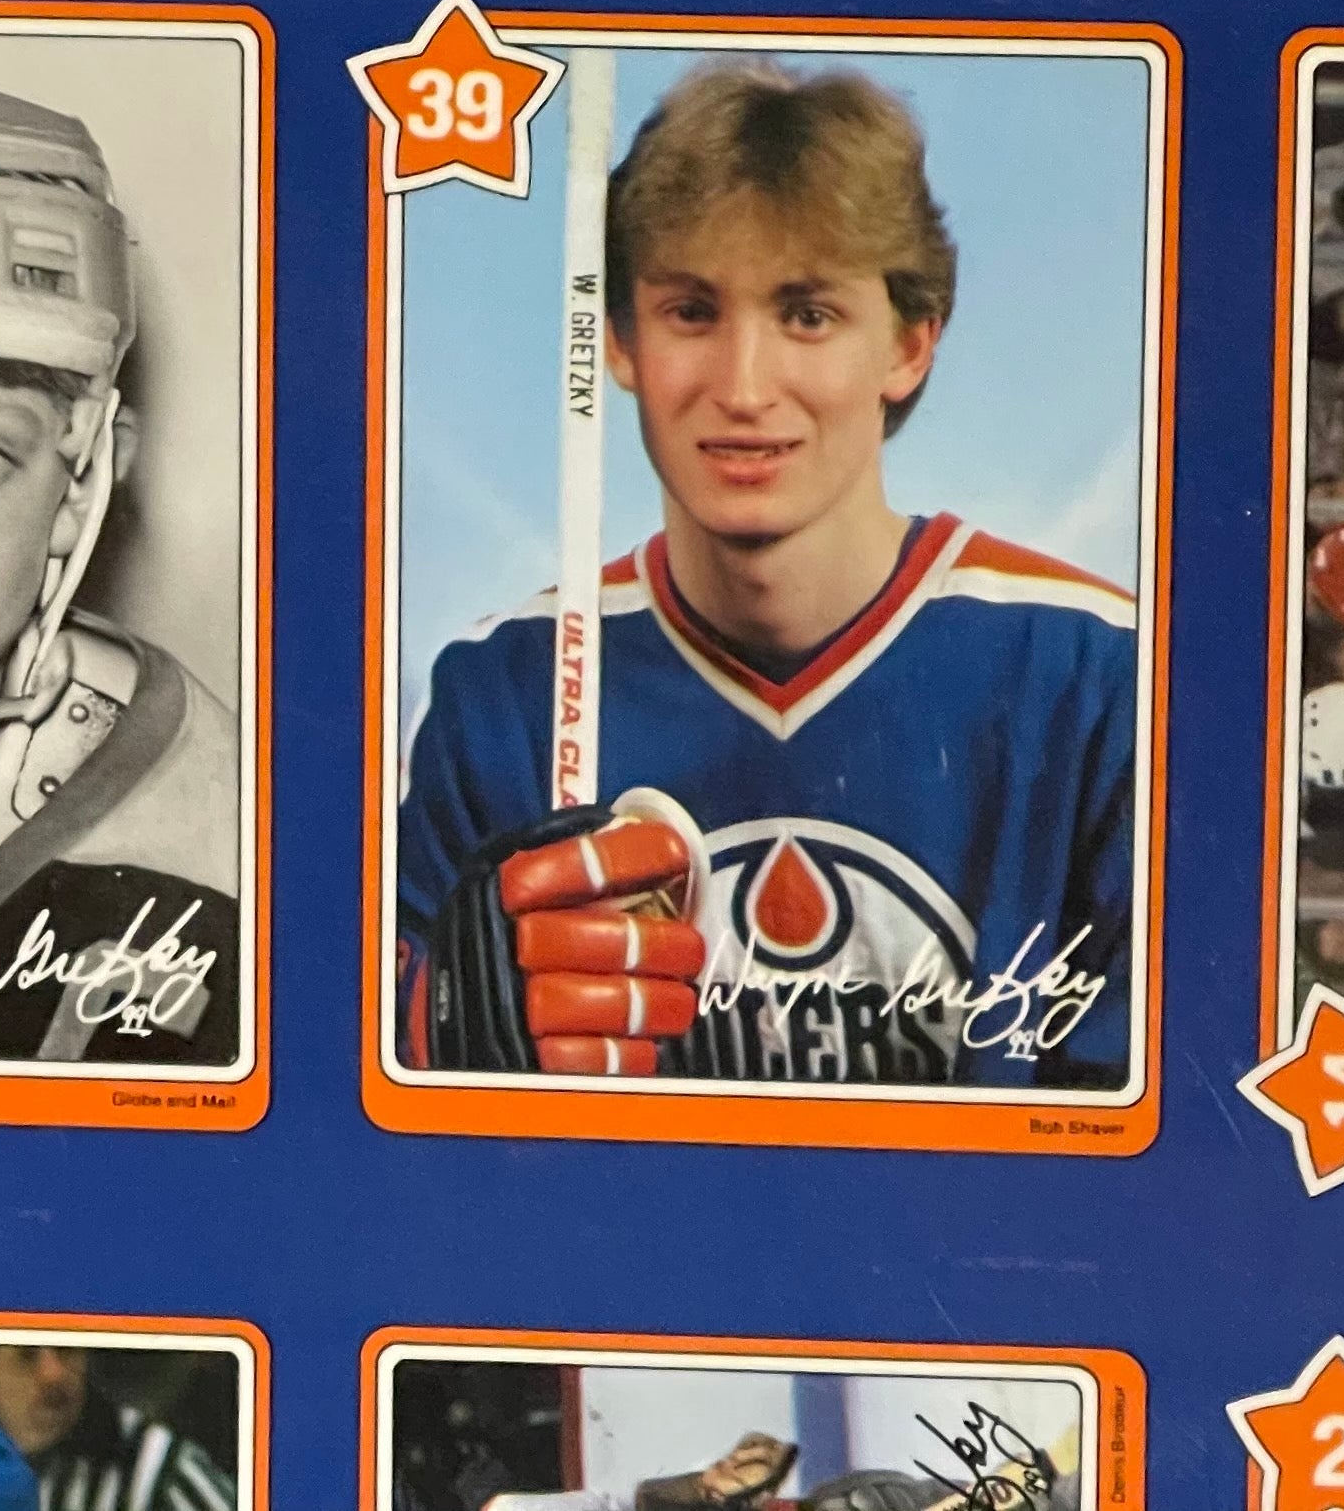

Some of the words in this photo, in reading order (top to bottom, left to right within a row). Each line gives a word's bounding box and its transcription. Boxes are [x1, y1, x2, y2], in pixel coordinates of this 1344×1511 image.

[407, 67, 505, 142] 39
[572, 274, 598, 300] W.
[569, 312, 596, 418] GRETZKY
[560, 611, 584, 726] ULTRA
[699, 928, 872, 1022] Wayne
[113, 1091, 162, 1106] Globe
[167, 1094, 197, 1108] and
[202, 1095, 235, 1107] Mail
[1030, 1118, 1064, 1135] Bob
